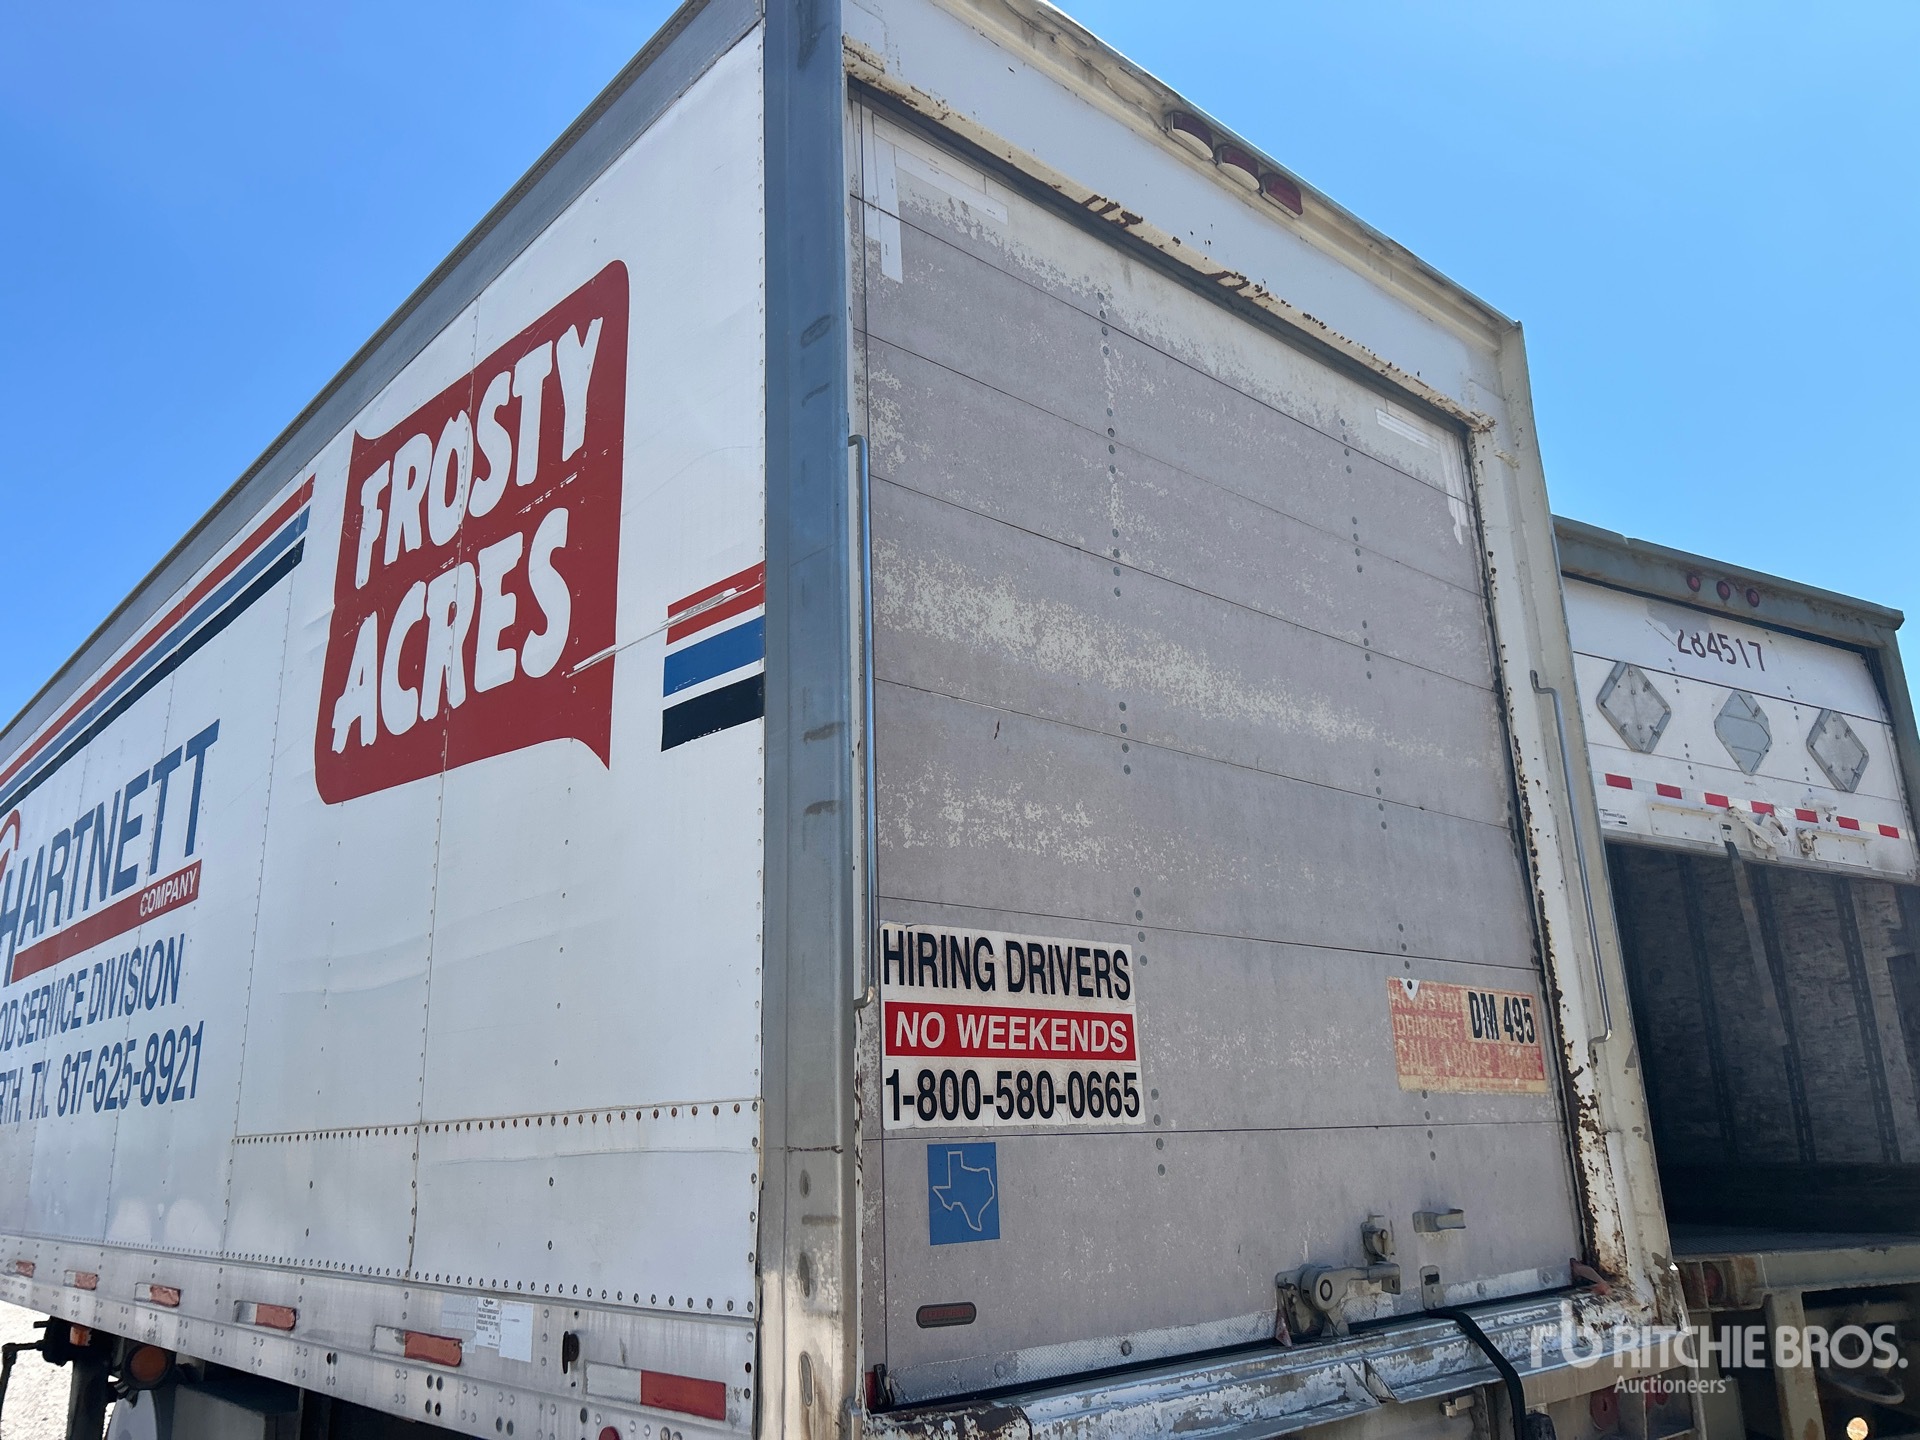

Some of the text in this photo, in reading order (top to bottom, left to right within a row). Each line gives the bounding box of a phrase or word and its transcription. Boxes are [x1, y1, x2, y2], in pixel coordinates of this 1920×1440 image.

[354, 317, 603, 589] FROSTY
[331, 507, 572, 753] ACRES
[0, 719, 221, 987] HARTNETT
[140, 867, 198, 917] COMPANY
[17, 967, 88, 1047] SERVICE
[87, 933, 185, 1024] DIVISION
[883, 929, 1132, 1001] HIRING DRIVERS
[895, 1011, 1128, 1054] NO WEEKENDS
[1468, 991, 1536, 1044] DM 495
[57, 1020, 205, 1118] 817-625-8921
[886, 1068, 1140, 1122] 1-800-580-0665
